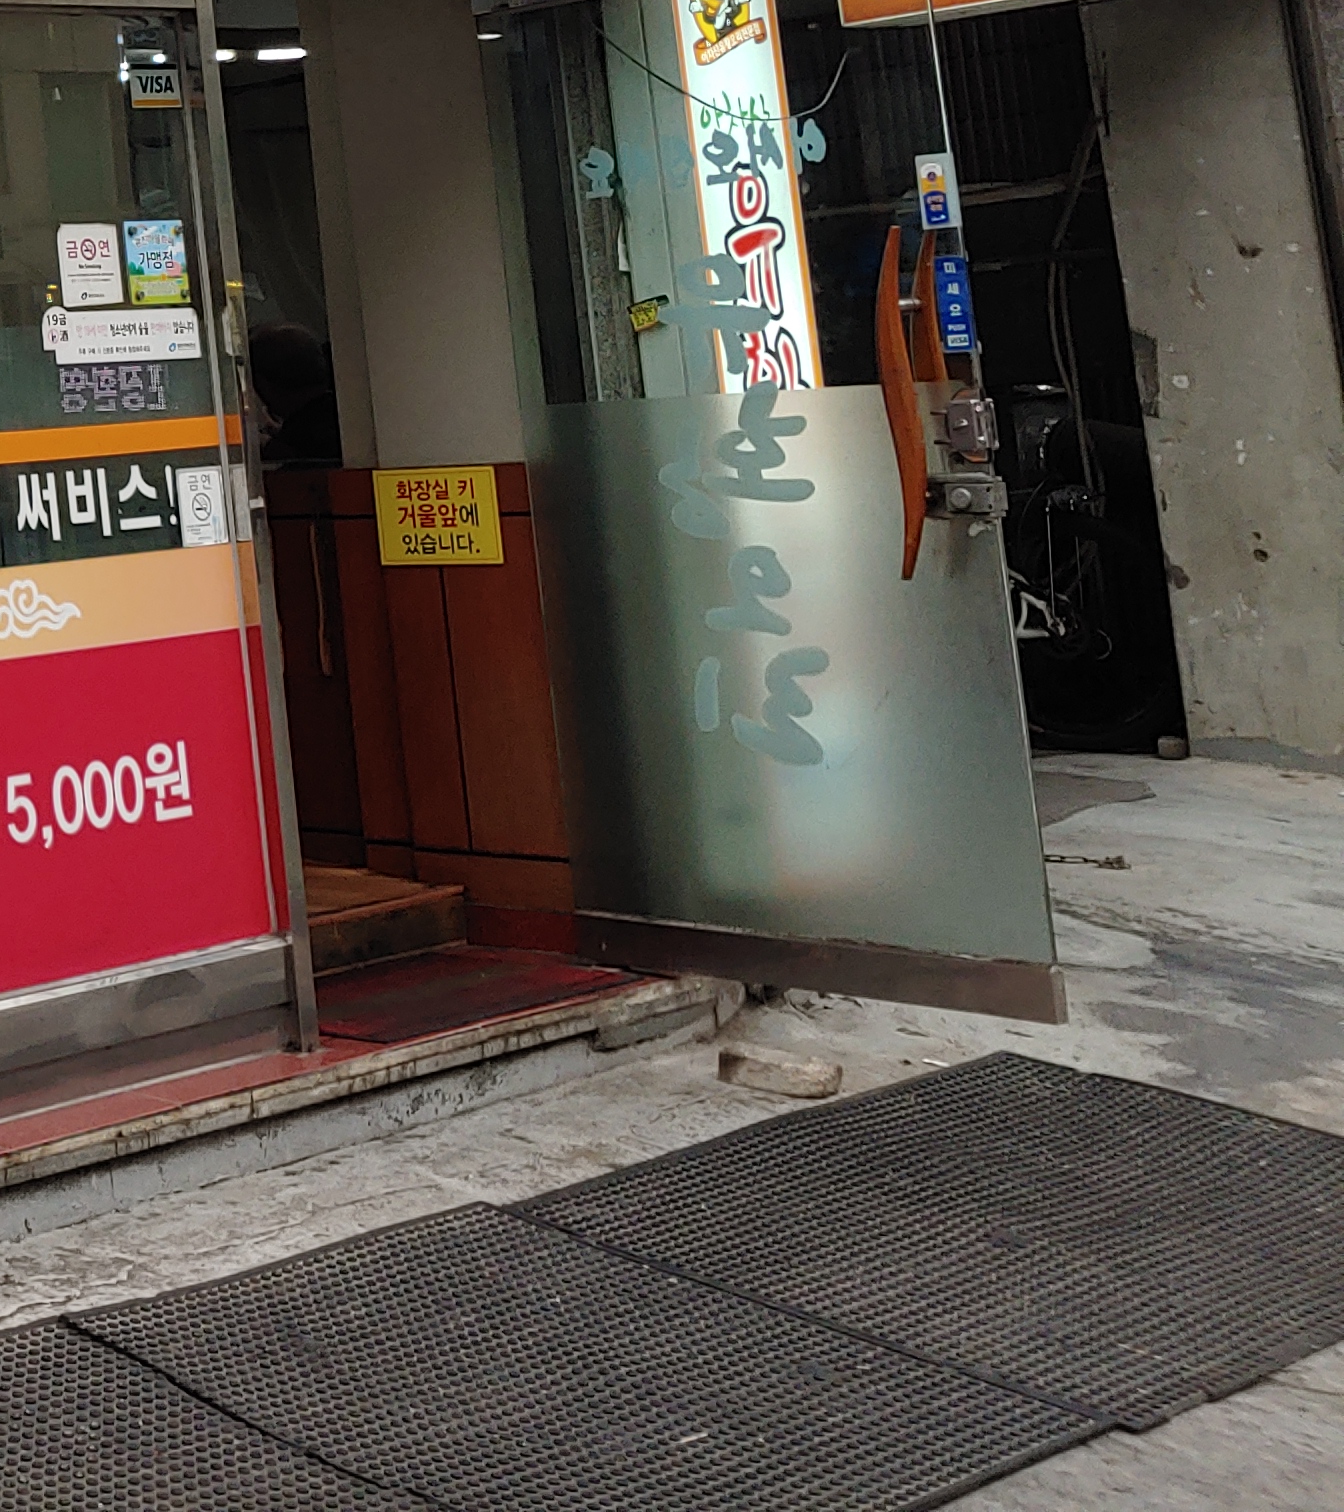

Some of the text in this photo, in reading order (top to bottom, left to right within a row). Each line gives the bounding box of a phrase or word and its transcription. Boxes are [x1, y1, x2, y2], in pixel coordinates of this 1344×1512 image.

[136, 75, 175, 94] VISA
[138, 250, 174, 270] 가맹점
[46, 314, 67, 326] 19금
[187, 474, 212, 492] 금연
[396, 477, 475, 501] 화장실 키
[16, 463, 179, 544] 써비스!
[397, 502, 480, 529] 거울앞에
[402, 532, 481, 555] 있습니다.
[5, 740, 194, 852] 5,000원
